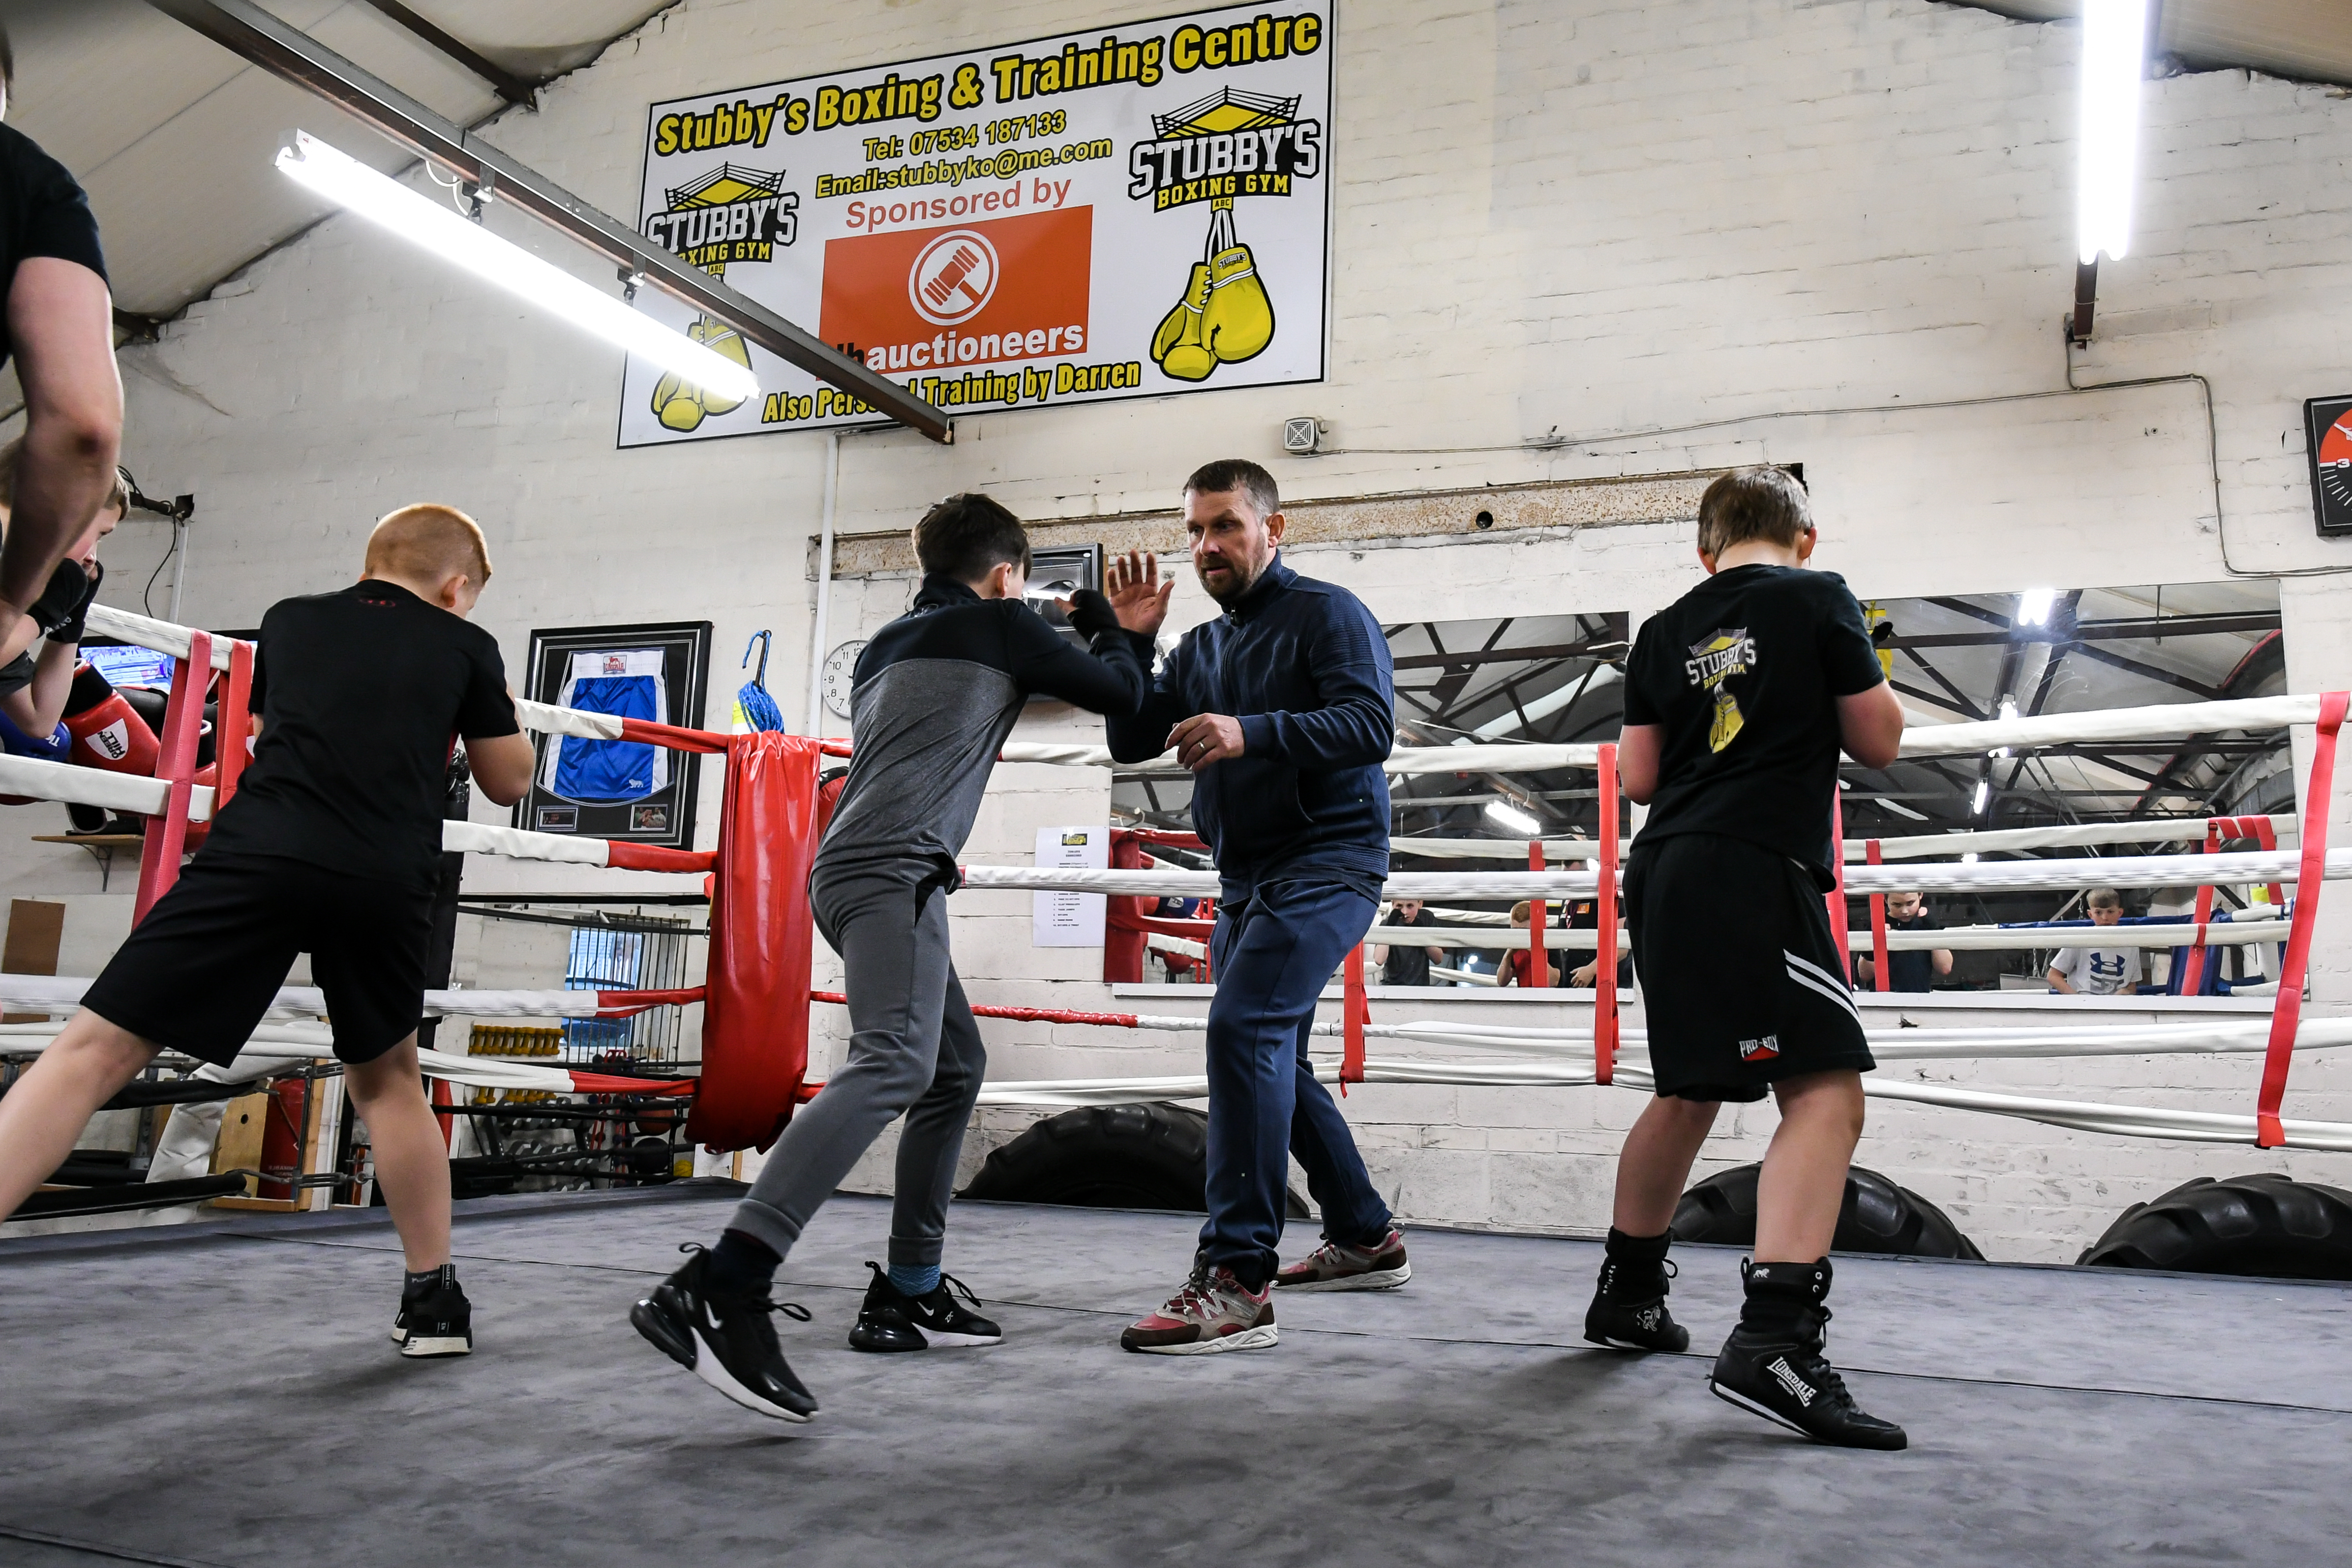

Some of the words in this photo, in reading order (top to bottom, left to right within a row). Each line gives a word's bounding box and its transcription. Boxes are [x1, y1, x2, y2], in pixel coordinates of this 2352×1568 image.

[655, 93, 809, 156] Stubby's
[813, 73, 943, 131] Boxing
[948, 62, 983, 110] &
[990, 36, 1165, 103] Training
[1170, 13, 1322, 73] Centre
[863, 136, 902, 161] Tel:
[910, 125, 979, 156] 07534
[985, 110, 1066, 144] 187133
[816, 138, 1112, 199] Email:stubbyko@me.com
[1129, 123, 1321, 197] STUBBY'S
[846, 182, 1021, 232] Sponsored
[1034, 178, 1071, 208] by
[1157, 175, 1236, 209] BOXING
[1246, 174, 1289, 194] GYM
[1215, 199, 1230, 208] ABC
[647, 194, 798, 254] STUBBY'S
[678, 244, 729, 266] XING
[735, 242, 770, 259] GYM
[710, 264, 722, 273] ABC
[837, 325, 1083, 372] hauctioneers
[761, 391, 812, 424] Also
[921, 370, 1019, 406] Training
[1023, 367, 1051, 402] by
[1055, 361, 1141, 396] Darren
[2337, 458, 2350, 468] 3
[832, 661, 841, 670] 10
[842, 651, 849, 659] 11
[1685, 638, 1756, 685] STUBBY'S
[828, 675, 834, 684] 9
[831, 688, 837, 697] 8
[839, 698, 845, 707] 7
[97, 731, 119, 759] GREEN
[1766, 1356, 1817, 1407] LONSDALE
